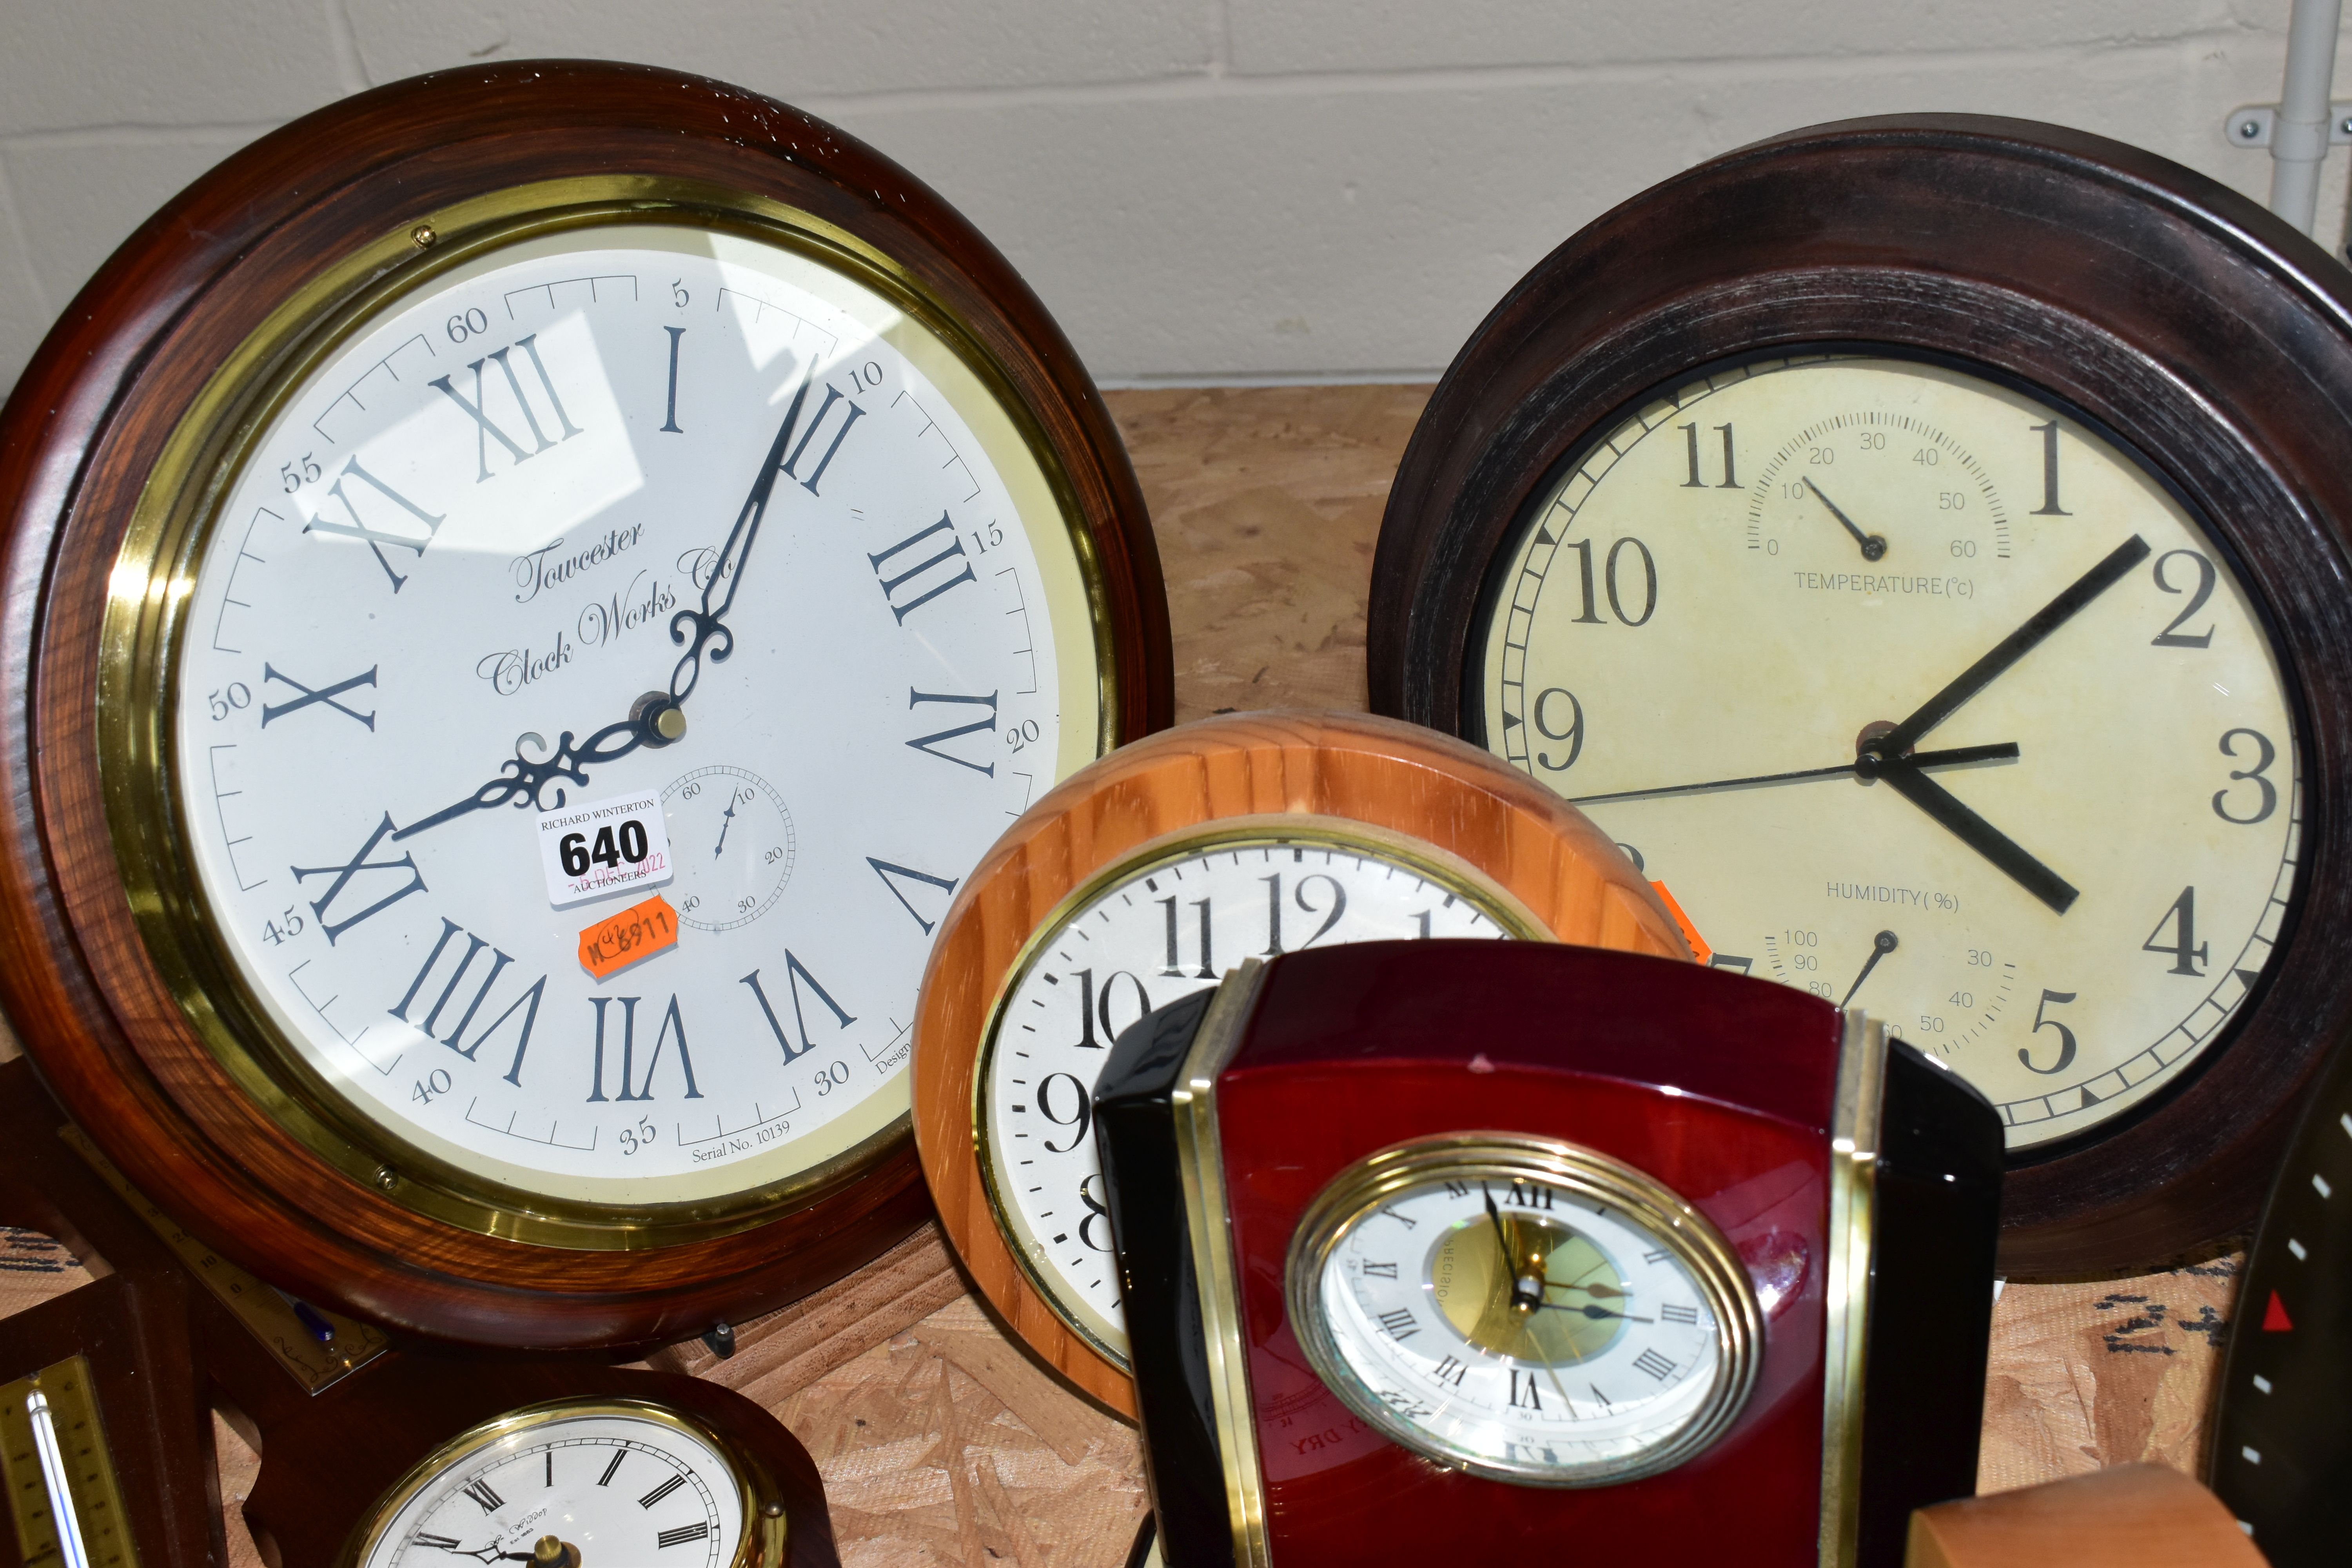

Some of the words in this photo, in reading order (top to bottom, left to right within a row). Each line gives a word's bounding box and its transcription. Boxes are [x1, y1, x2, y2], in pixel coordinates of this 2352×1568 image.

[671, 277, 690, 308] 5
[446, 308, 488, 344] 60
[848, 361, 884, 394] 10
[428, 333, 584, 483] XII
[1677, 421, 1745, 489] 11
[1809, 447, 1834, 465] 20
[1860, 433, 1886, 450] 30
[1912, 448, 1939, 466] 40
[280, 452, 322, 494] 55
[2029, 419, 2074, 516] 1
[1782, 483, 1804, 500] 10
[1939, 492, 1965, 511] 50
[302, 454, 447, 593] XI
[971, 518, 1003, 555] 15
[509, 523, 645, 603] Towcester
[1767, 540, 1779, 556] 0
[1950, 540, 1976, 559] 60
[867, 509, 977, 627] III
[1567, 537, 1658, 627] 10
[2151, 548, 2217, 649] 2
[476, 631, 574, 696] Clock
[577, 569, 676, 648] Works
[209, 682, 251, 722] 50
[261, 661, 377, 732] X
[1006, 719, 1040, 754] 20
[1534, 687, 1584, 772] 9
[681, 782, 702, 800] 60
[2211, 727, 2277, 824] 3
[541, 813, 590, 831] RICHARD
[592, 799, 655, 819] WINTERTON
[737, 787, 756, 806] 10
[559, 820, 648, 877] 640
[764, 846, 783, 865] 20
[573, 869, 647, 893] AUCTIONEERS
[865, 856, 960, 936] V
[681, 895, 701, 913] 40
[737, 895, 757, 913] 30
[1258, 873, 1347, 956] 12
[262, 904, 304, 946] 45
[1154, 895, 1222, 980] 11
[1784, 929, 1817, 947] 100
[2141, 886, 2208, 978] 4
[1794, 955, 1817, 971] 90
[1967, 949, 1992, 967] 30
[1809, 981, 1831, 998] 80
[1949, 991, 1974, 1009] 40
[1070, 968, 1151, 1049] 10
[1920, 1016, 1944, 1033] 50
[2017, 988, 2077, 1074] 5
[411, 1068, 452, 1106] 40
[813, 1060, 850, 1097] 30
[1036, 1072, 1091, 1153] 9
[619, 1115, 656, 1156] 35
[693, 1143, 727, 1163] Serial
[729, 1139, 753, 1153] No.
[756, 1121, 790, 1144] 10139
[509, 1508, 547, 1534] Widdop
